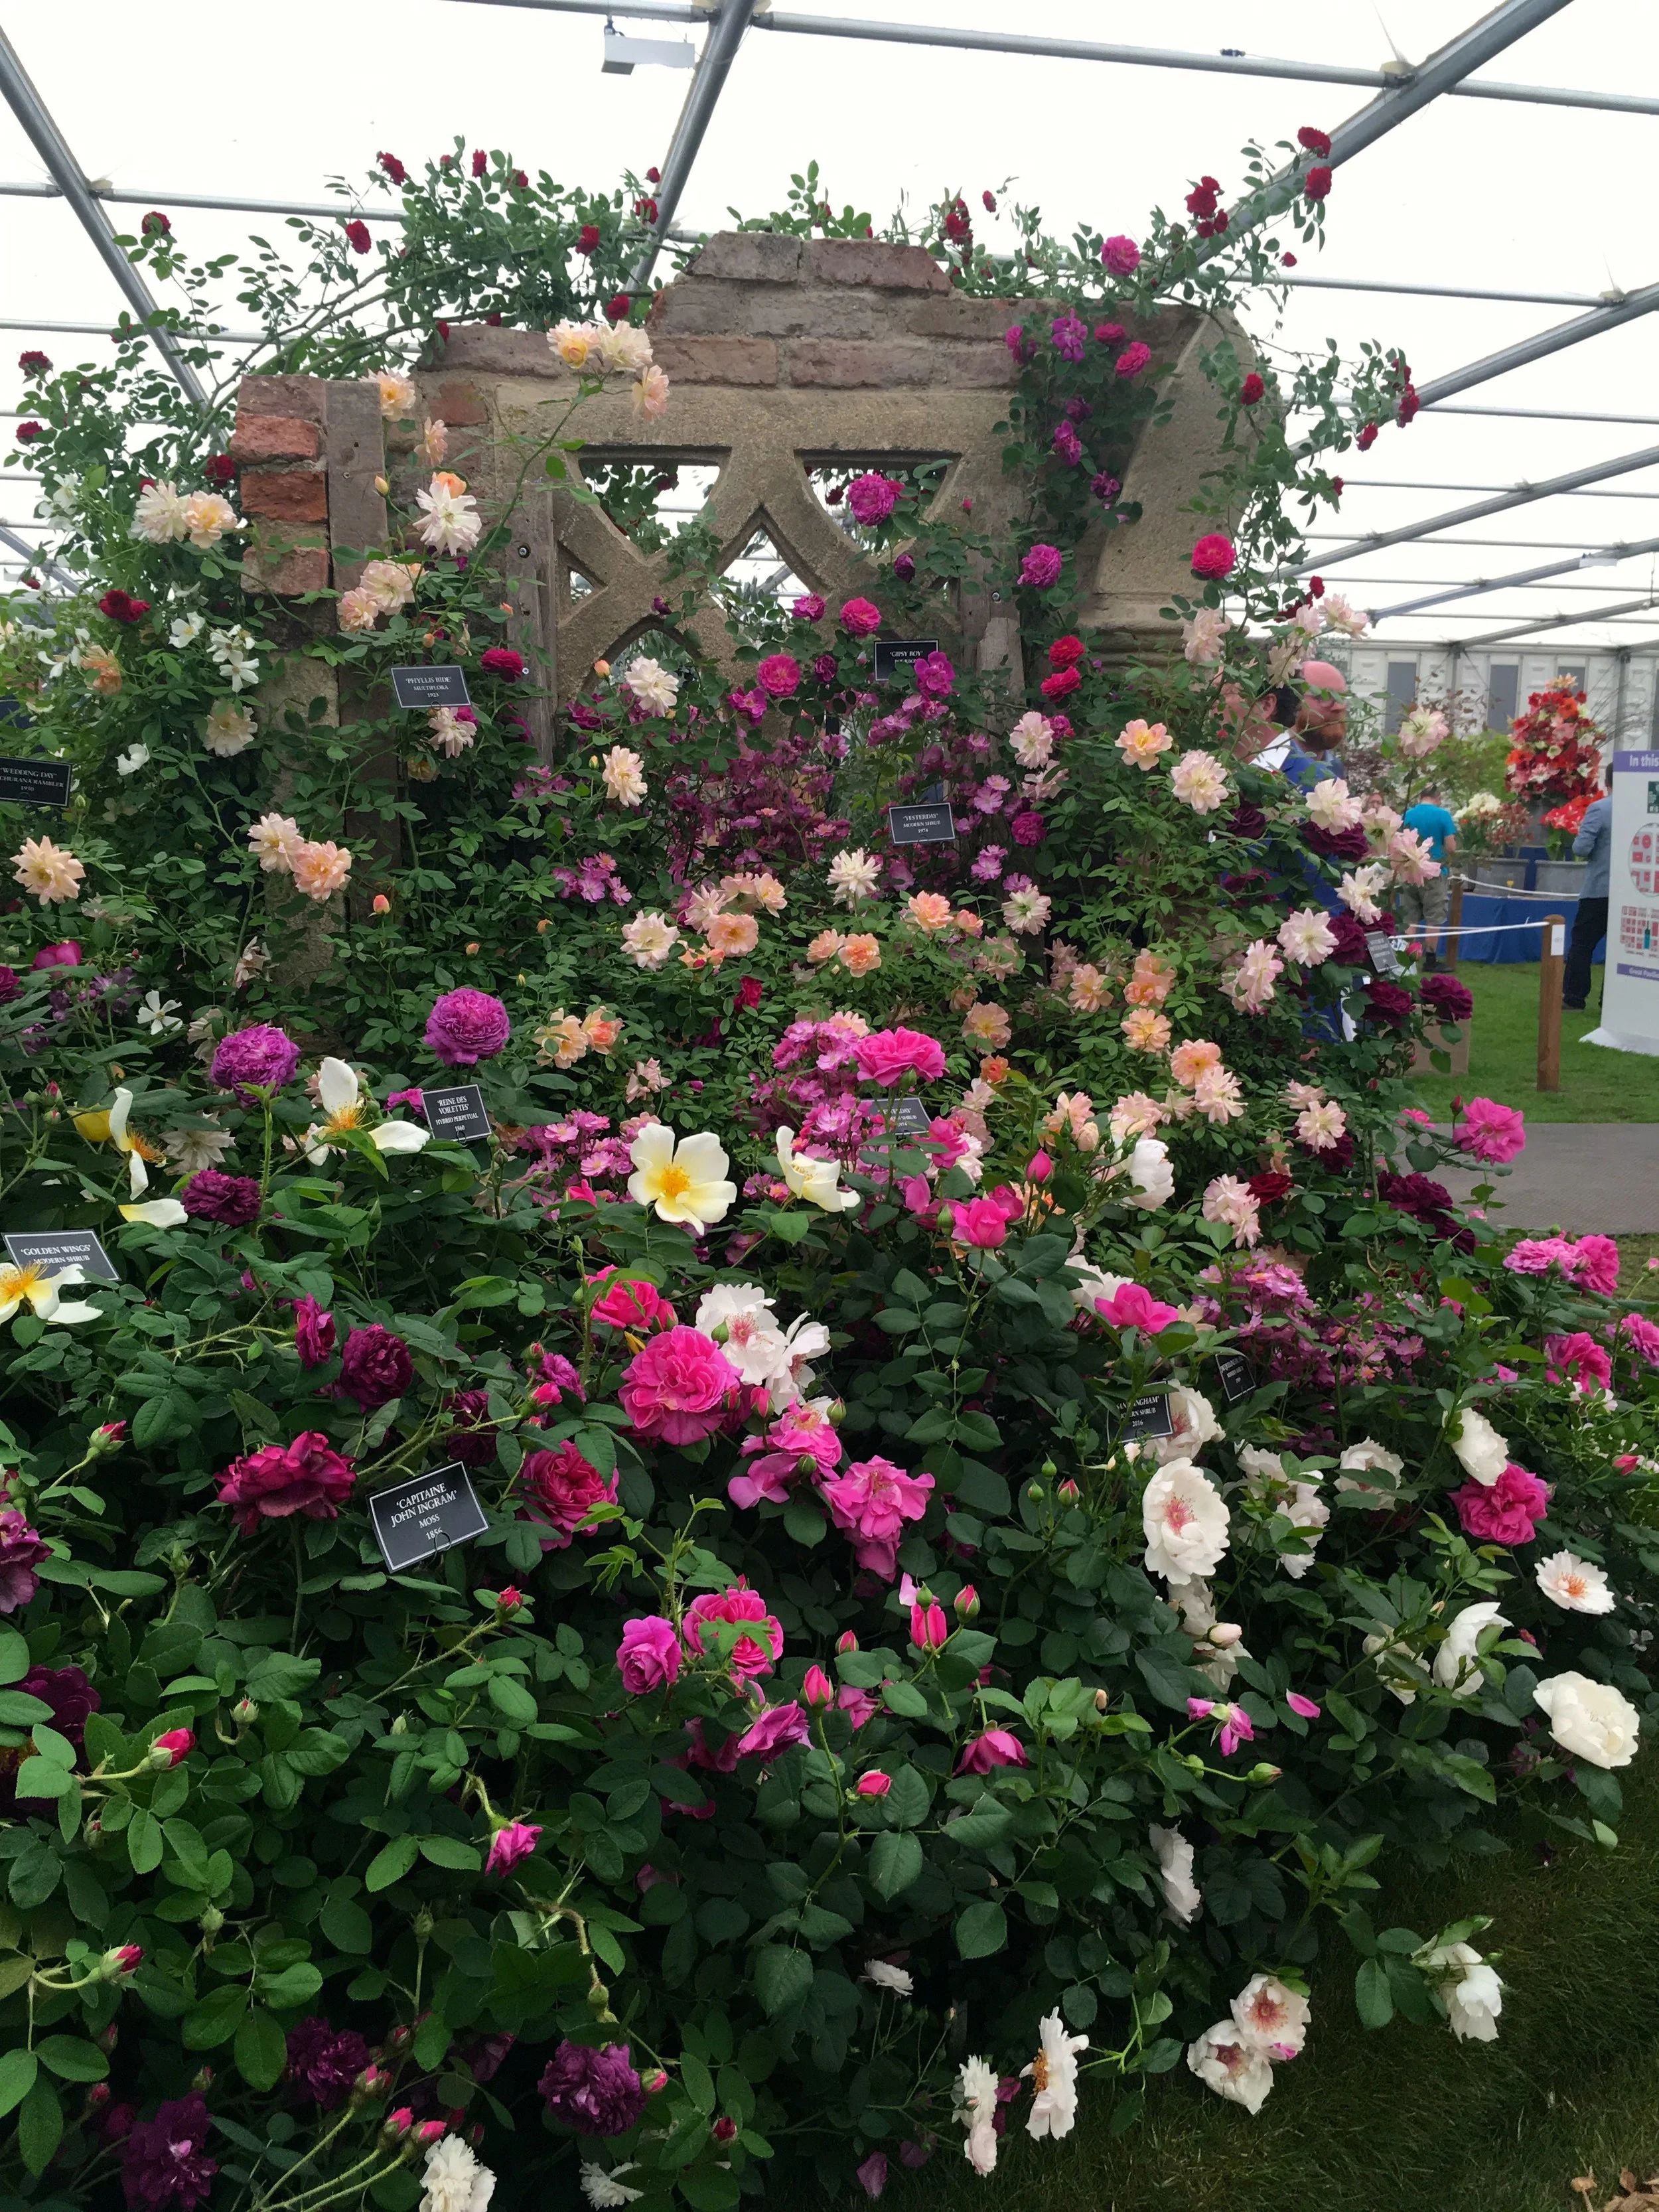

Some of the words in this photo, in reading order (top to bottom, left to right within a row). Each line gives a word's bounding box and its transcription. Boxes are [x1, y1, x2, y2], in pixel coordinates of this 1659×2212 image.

[1629, 755, 1638, 767] In
[1640, 753, 1659, 767] this
[437, 1097, 456, 1106] 'REINE
[435, 1117, 454, 1126] HYBRID
[454, 1112, 479, 1122] PERPETUAL
[21, 1246, 60, 1256] 'GOLDEN
[60, 1244, 91, 1254] WINGS'
[33, 1256, 66, 1265] MODERN
[396, 1483, 447, 1509] 'CAPITAINE
[390, 1507, 417, 1528] JOHN
[418, 1489, 457, 1514] INGRAM'
[419, 1513, 441, 1528] MOSS
